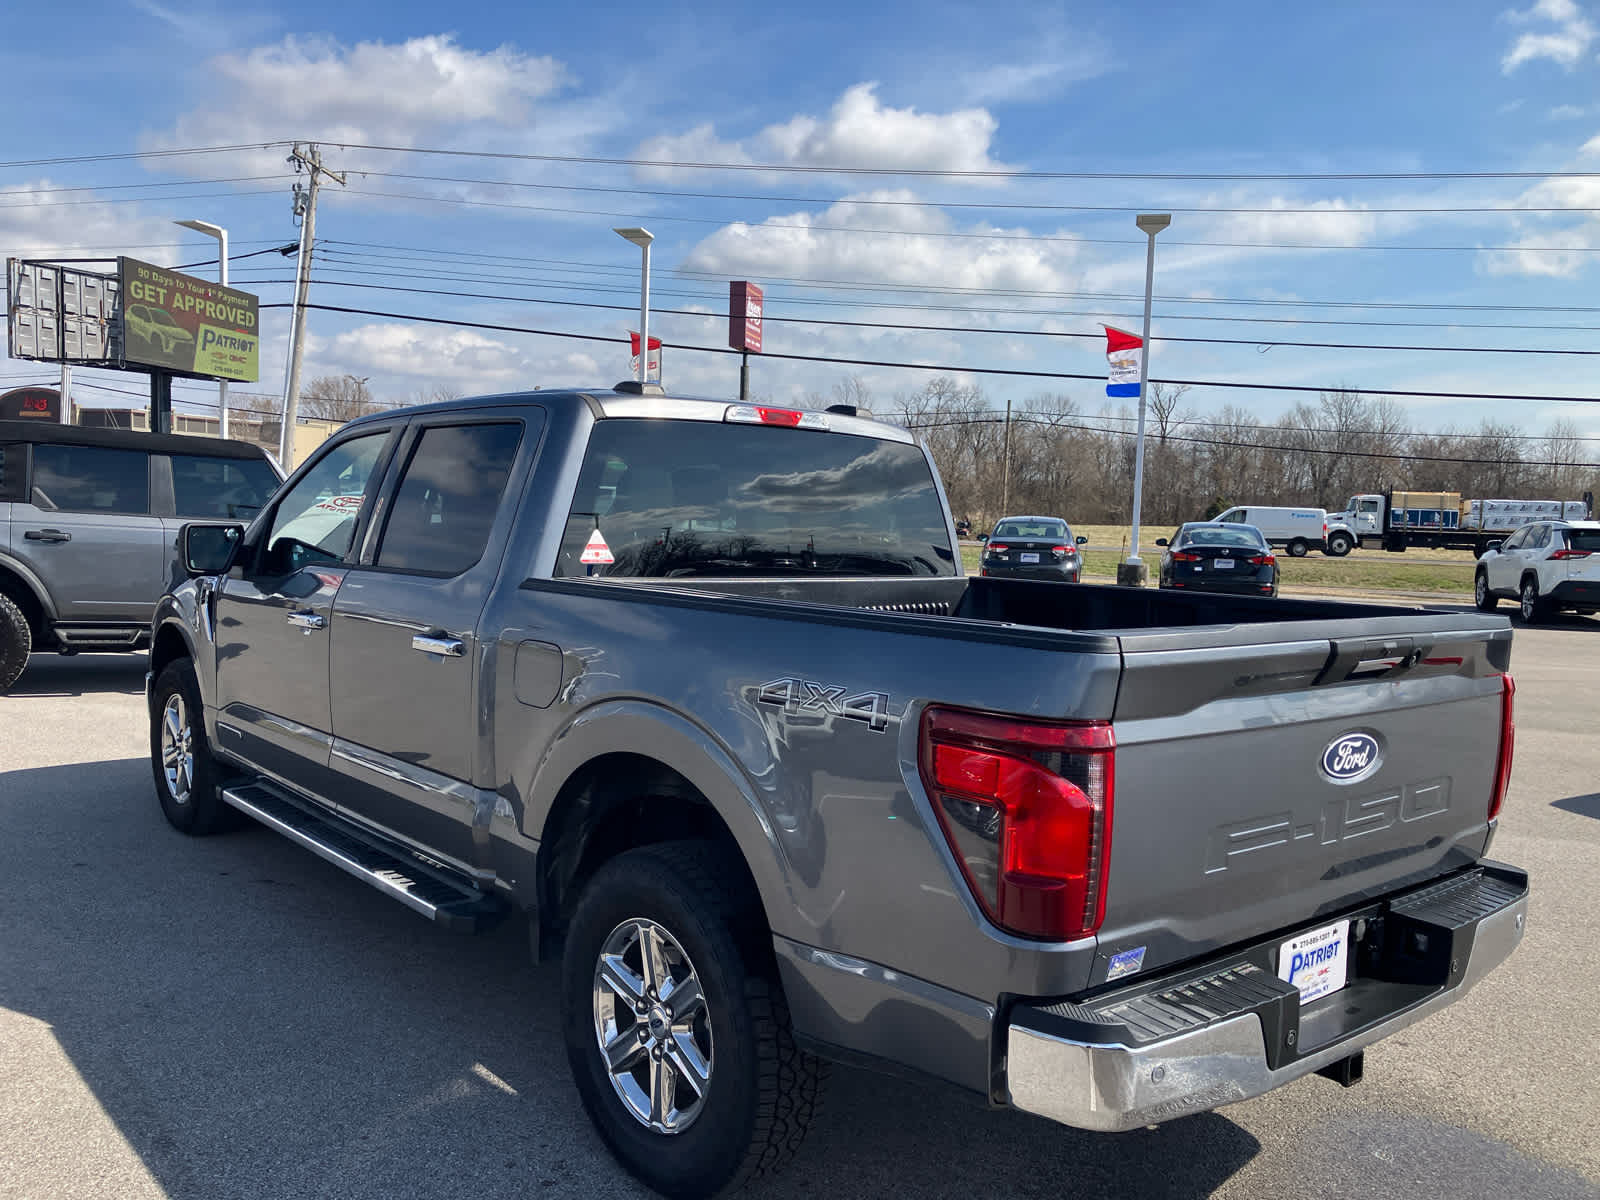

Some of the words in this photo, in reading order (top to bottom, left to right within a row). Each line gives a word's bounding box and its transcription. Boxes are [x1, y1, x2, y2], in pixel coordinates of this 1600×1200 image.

[137, 267, 150, 279] 90
[152, 271, 174, 287] Days
[187, 281, 205, 294] Your
[130, 280, 168, 305] GET
[172, 292, 256, 328] APPROVED
[201, 329, 255, 352] PATRIOT
[1333, 740, 1369, 772] Ford
[1204, 776, 1453, 875] F-150
[1288, 940, 1341, 985] PATRIOT
